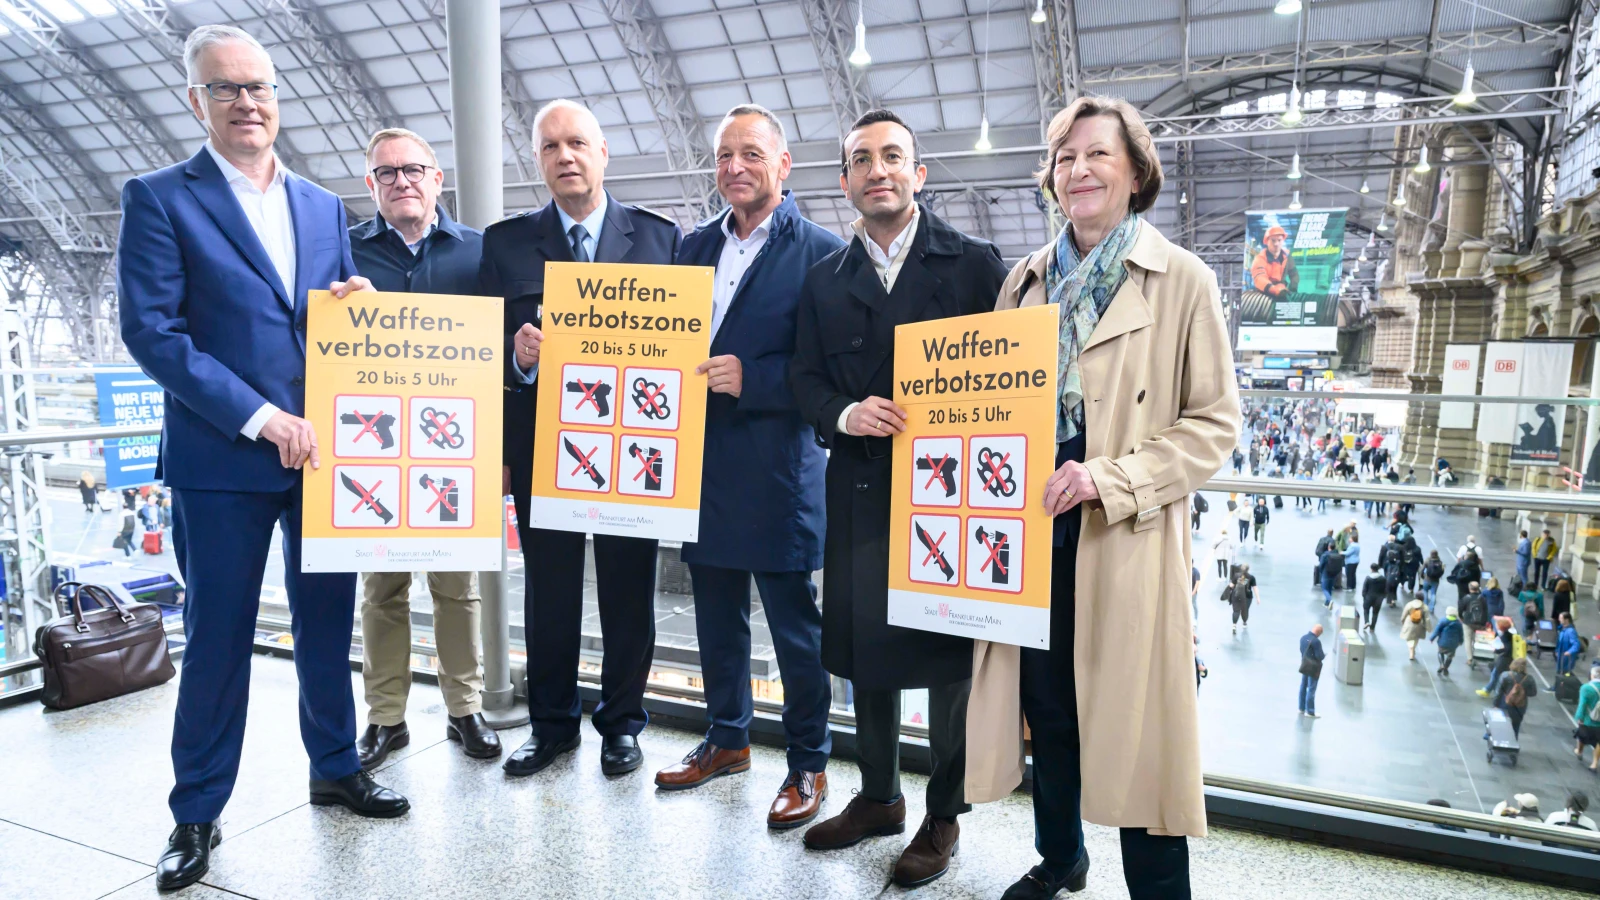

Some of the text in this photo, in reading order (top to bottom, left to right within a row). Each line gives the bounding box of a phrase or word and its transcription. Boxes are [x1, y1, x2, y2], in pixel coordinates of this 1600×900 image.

[576, 277, 677, 303] Waffen-
[347, 306, 465, 332] Waffen-
[550, 305, 702, 333] verbotszone
[316, 334, 494, 362] verbotszone
[580, 340, 668, 358] 20 bis 5 Uhr
[922, 330, 1020, 363] Waffen-
[1454, 361, 1468, 369] DB
[1497, 361, 1513, 371] DB
[356, 370, 458, 386] 20 bis 5 Uhr
[900, 368, 1047, 397] verbotszone
[112, 392, 140, 406] WIR
[114, 405, 152, 420] NEUE
[928, 405, 1012, 424] 20 bis 5 Uhr
